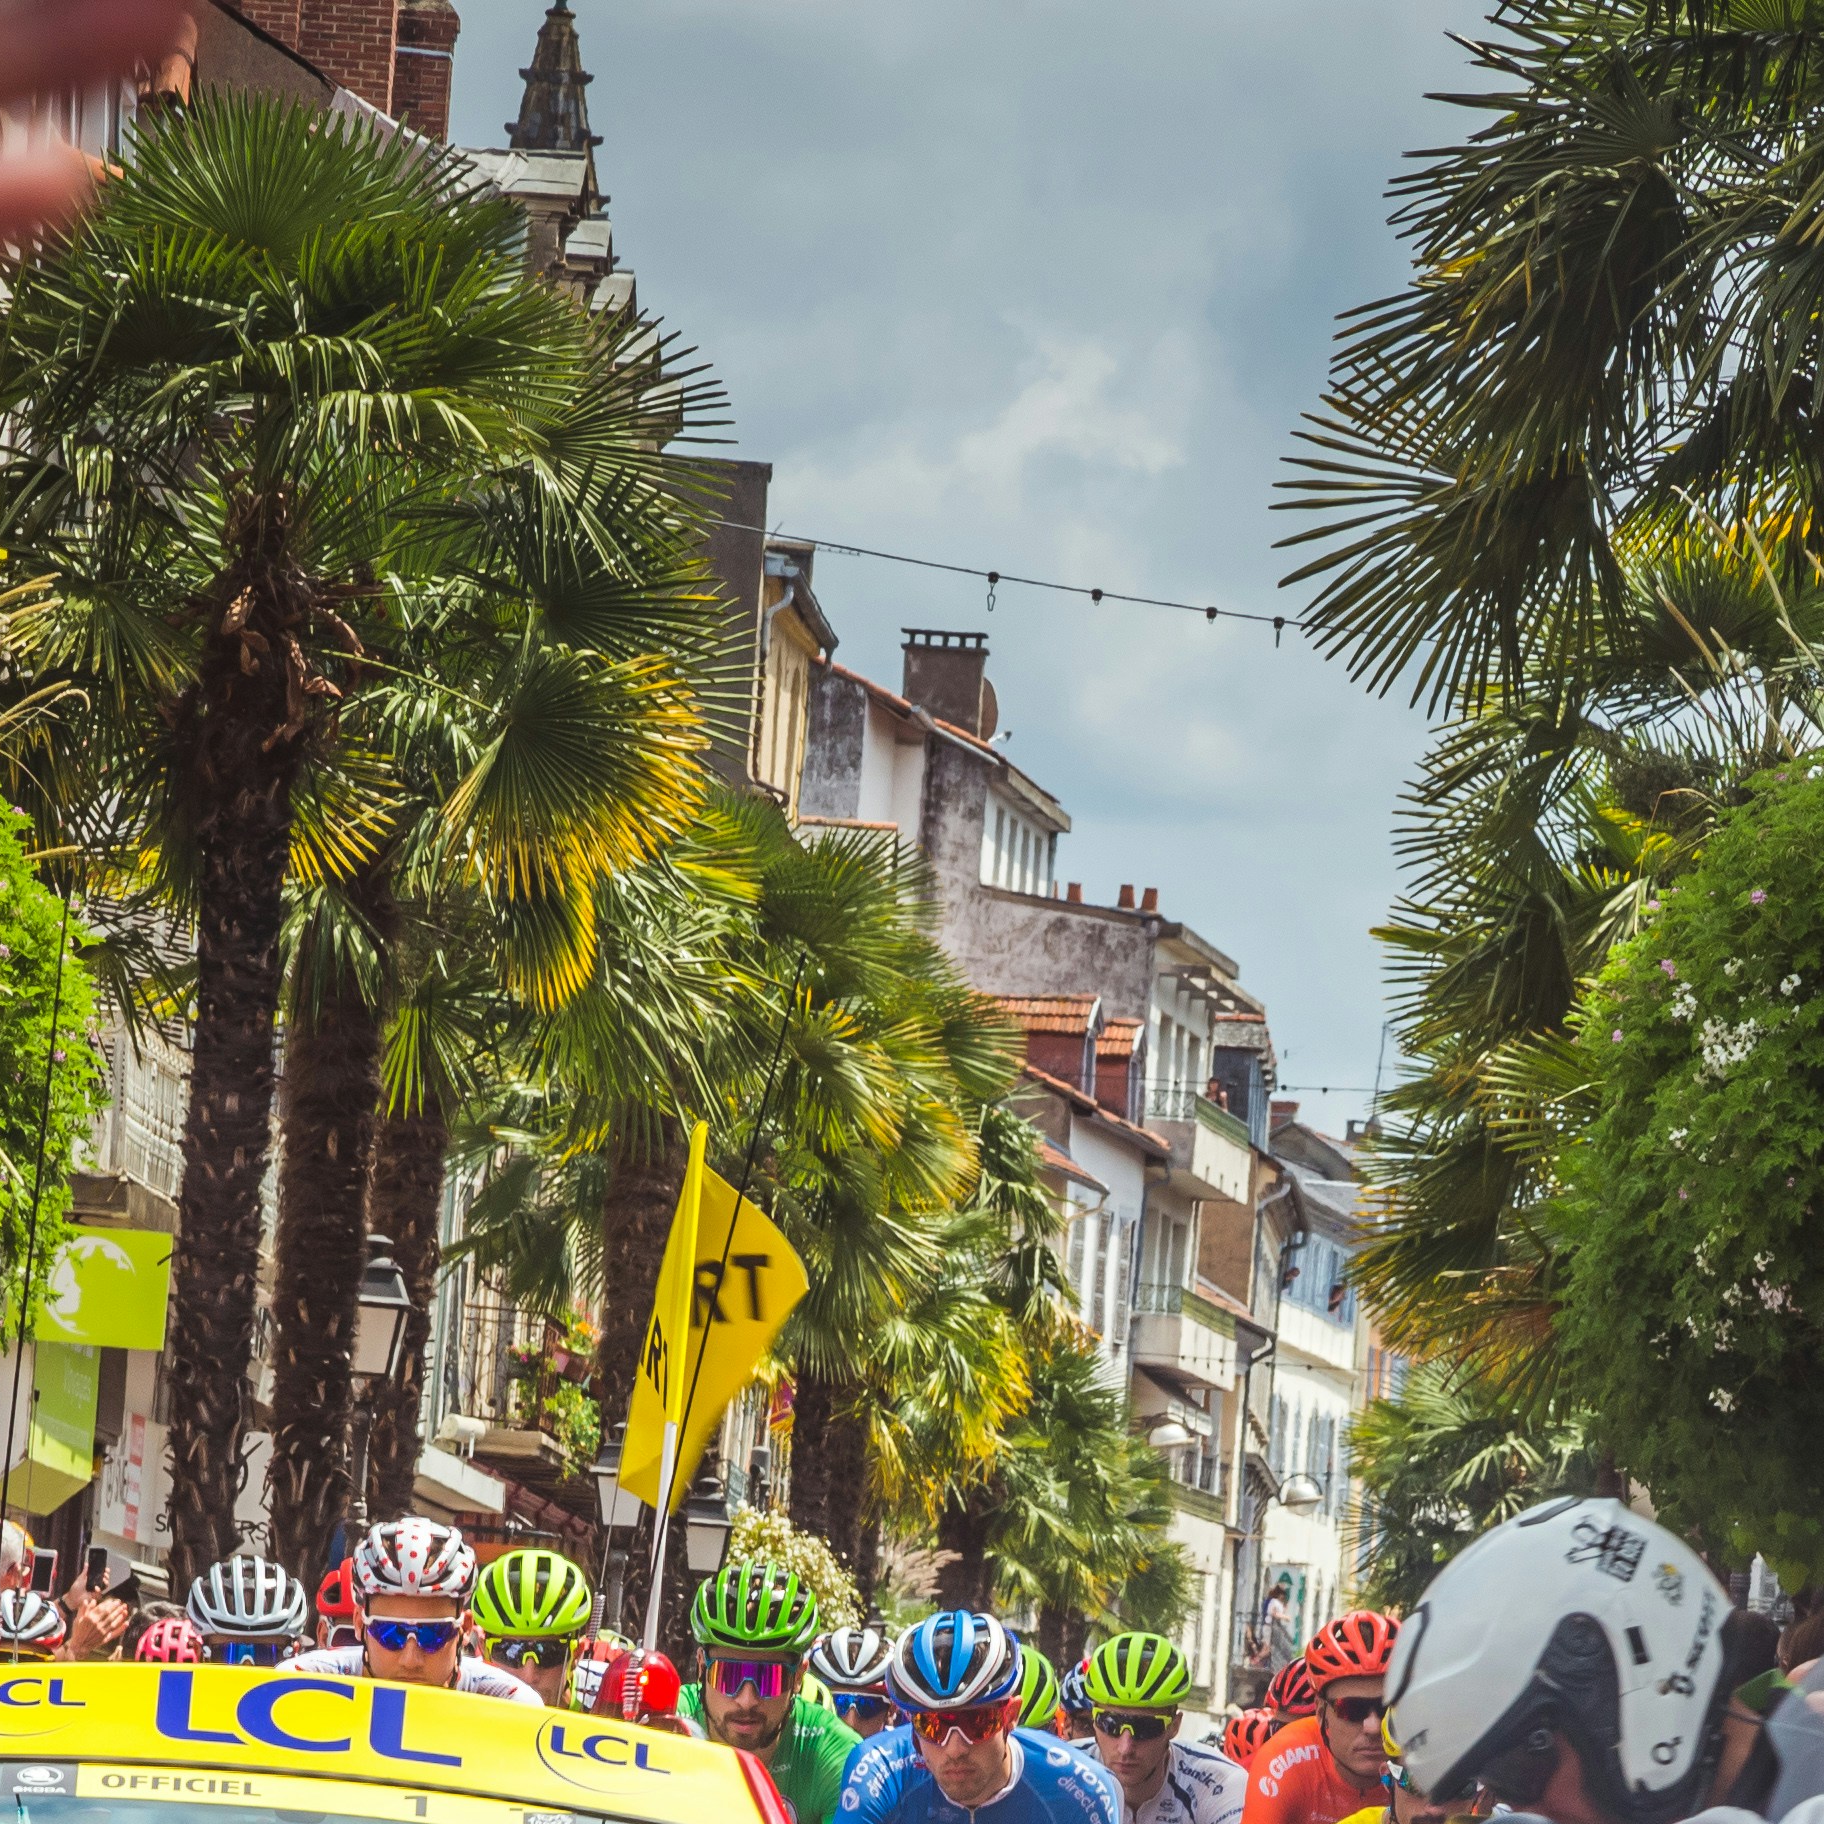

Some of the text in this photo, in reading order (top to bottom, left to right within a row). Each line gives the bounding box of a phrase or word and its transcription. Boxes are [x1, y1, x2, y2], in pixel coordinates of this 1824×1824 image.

[155, 1669, 463, 1768] LCL
[549, 1723, 671, 1776] LCL
[848, 1745, 893, 1785] TOTAL
[1269, 1744, 1321, 1780] GIANT
[100, 1773, 262, 1797] OFFICIEL
[1057, 1775, 1096, 1815] direct
[1073, 1759, 1114, 1824] TOTAL
